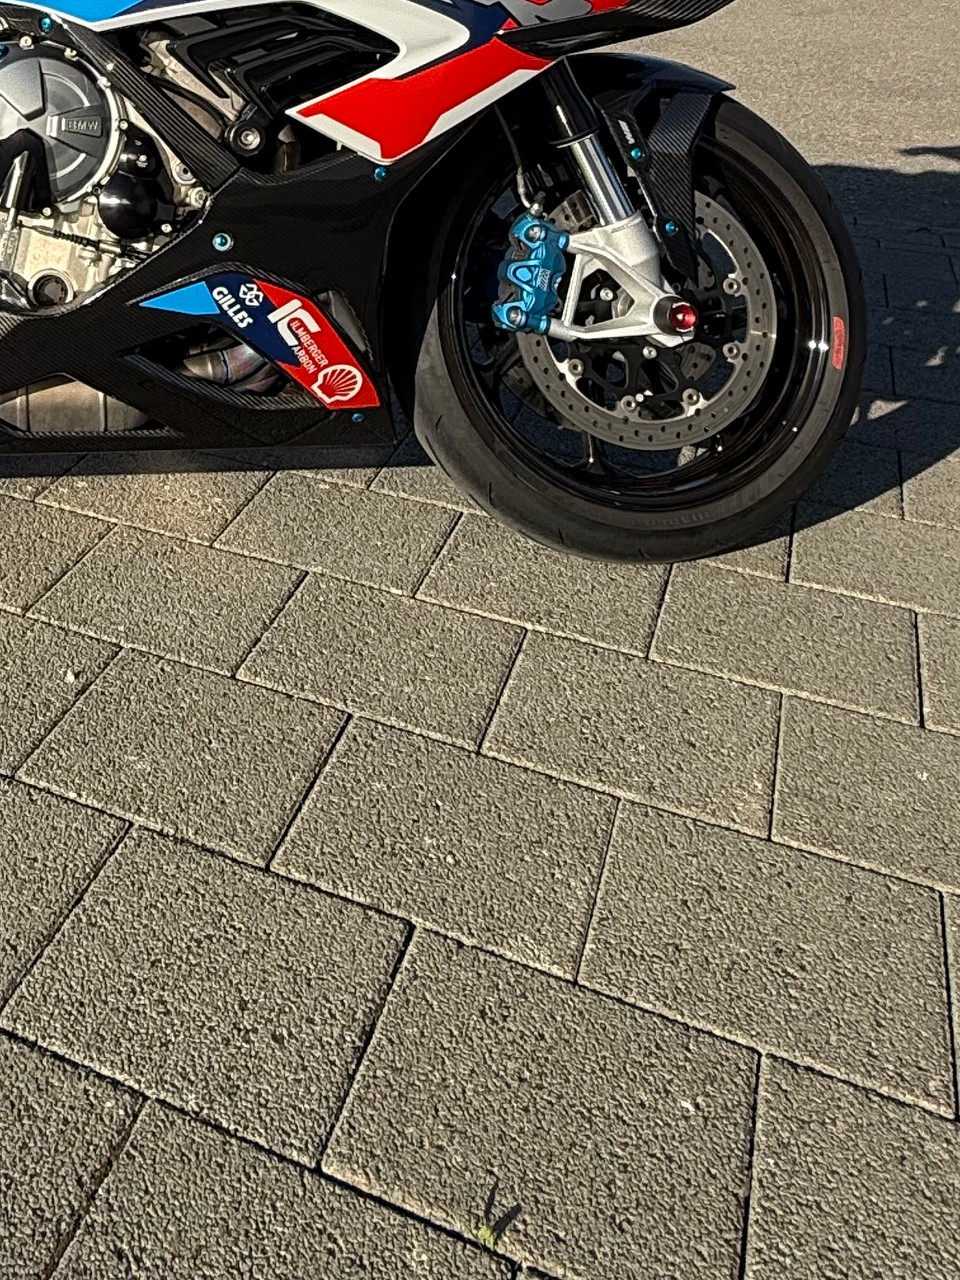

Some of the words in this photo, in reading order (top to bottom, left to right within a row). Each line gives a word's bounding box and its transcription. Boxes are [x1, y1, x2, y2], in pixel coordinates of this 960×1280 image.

[68, 120, 98, 131] BMW
[212, 286, 254, 329] GILLES
[290, 320, 329, 368] ILMBERGER
